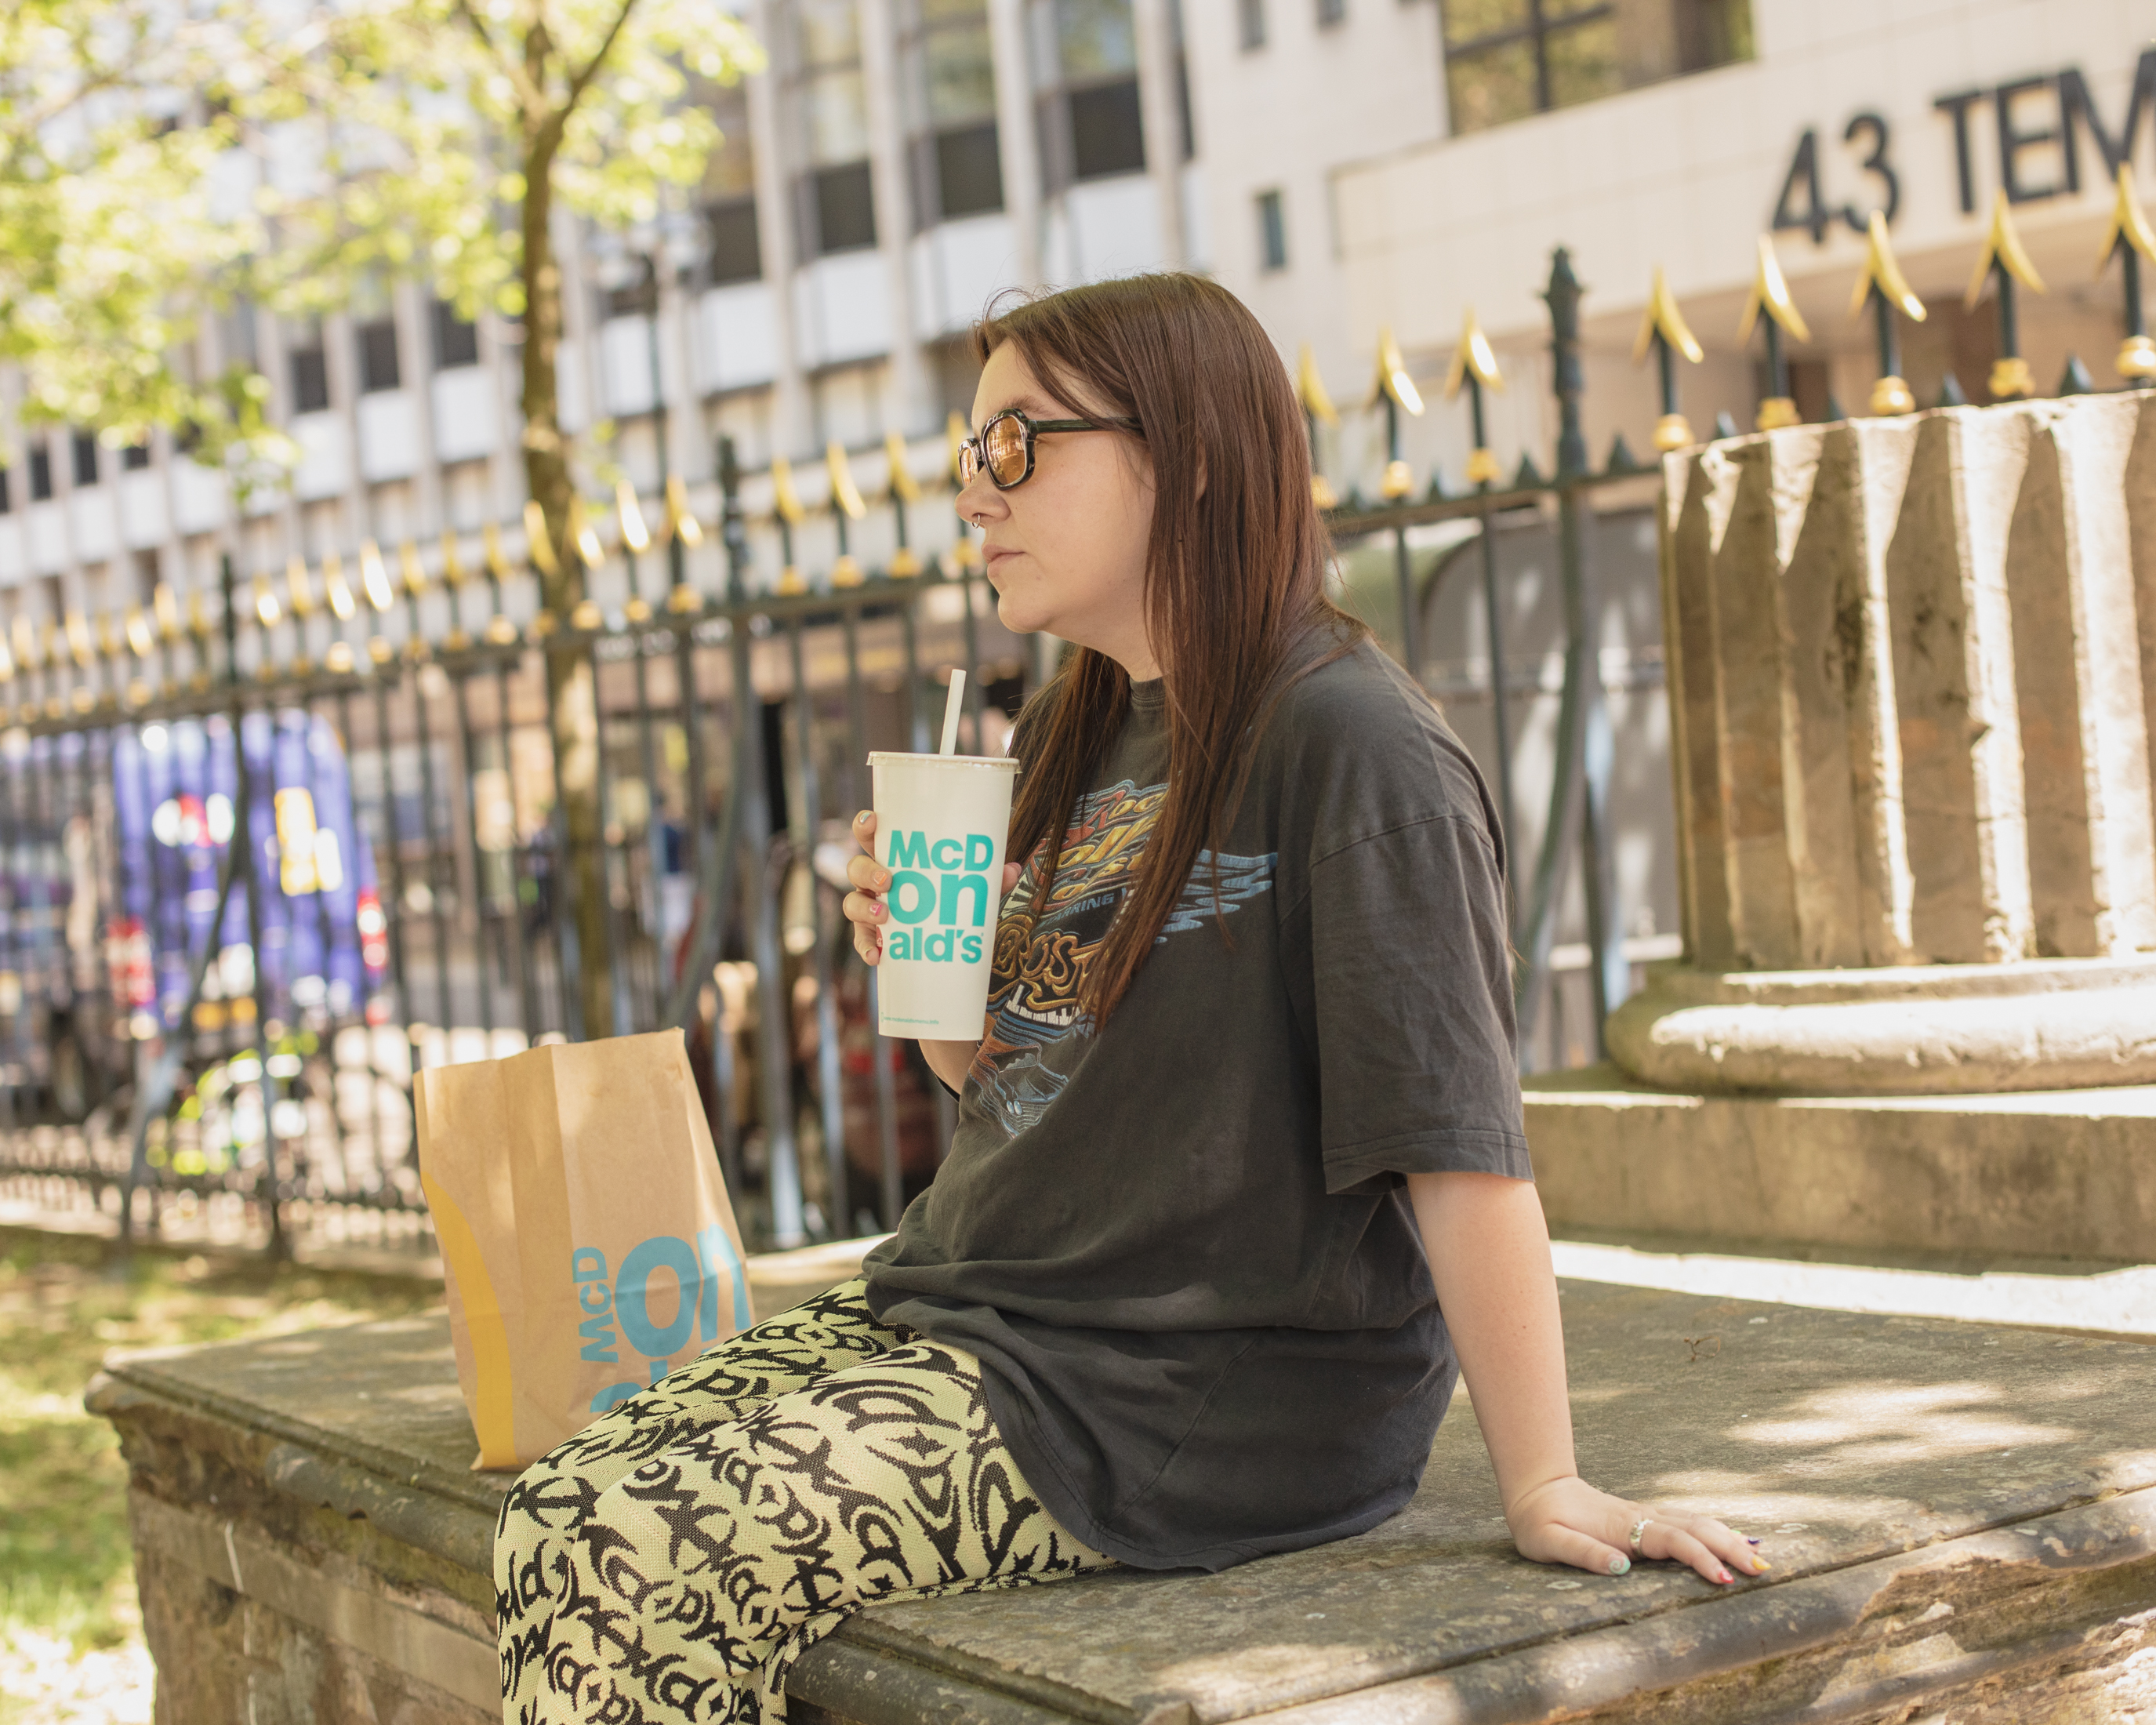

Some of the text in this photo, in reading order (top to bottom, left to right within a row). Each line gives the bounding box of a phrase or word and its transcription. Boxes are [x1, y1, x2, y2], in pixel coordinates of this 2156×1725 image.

[1771, 113, 1900, 244] 43
[887, 830, 994, 872] McD
[887, 870, 989, 927] on
[888, 927, 983, 964] ald's
[572, 1247, 619, 1363] McD
